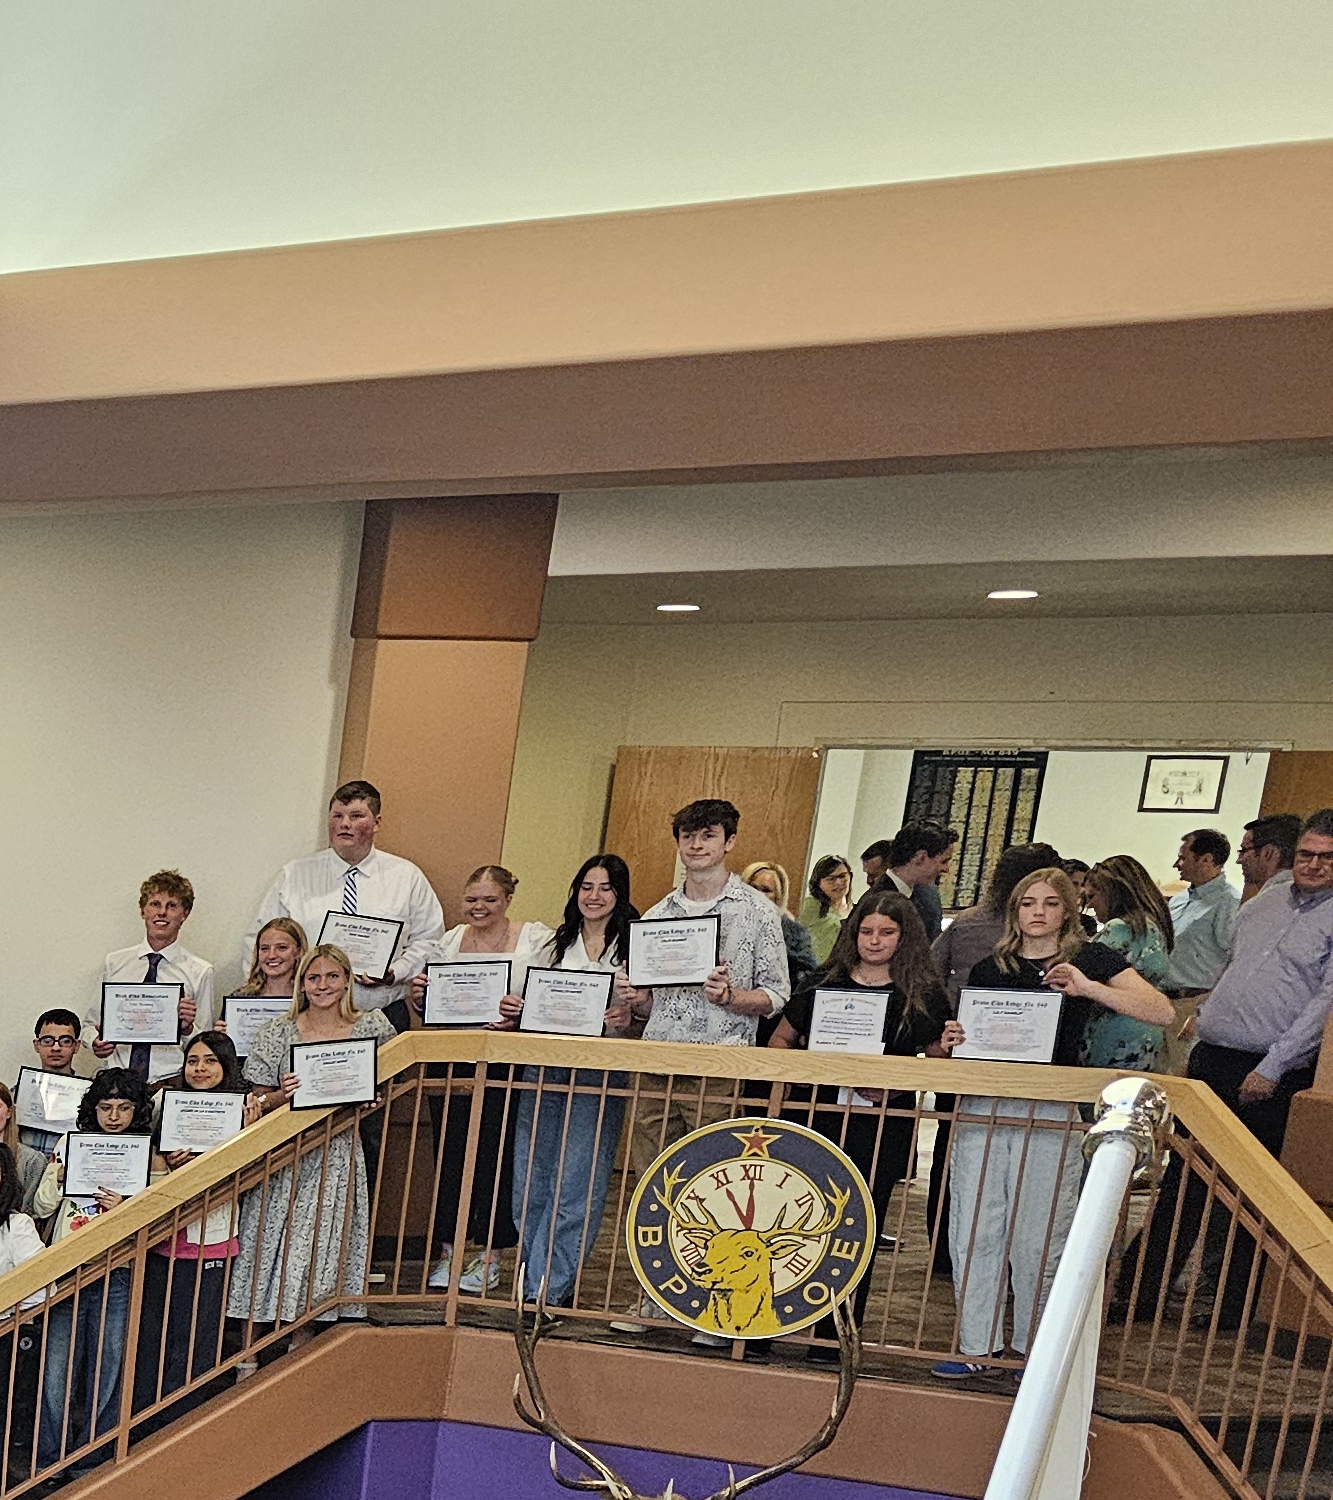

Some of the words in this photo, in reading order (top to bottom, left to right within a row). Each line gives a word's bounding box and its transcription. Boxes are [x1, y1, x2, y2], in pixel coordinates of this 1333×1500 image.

[638, 1225, 662, 1247] B
[658, 1273, 688, 1297] P
[803, 1281, 829, 1306] O
[831, 1240, 860, 1262] E
